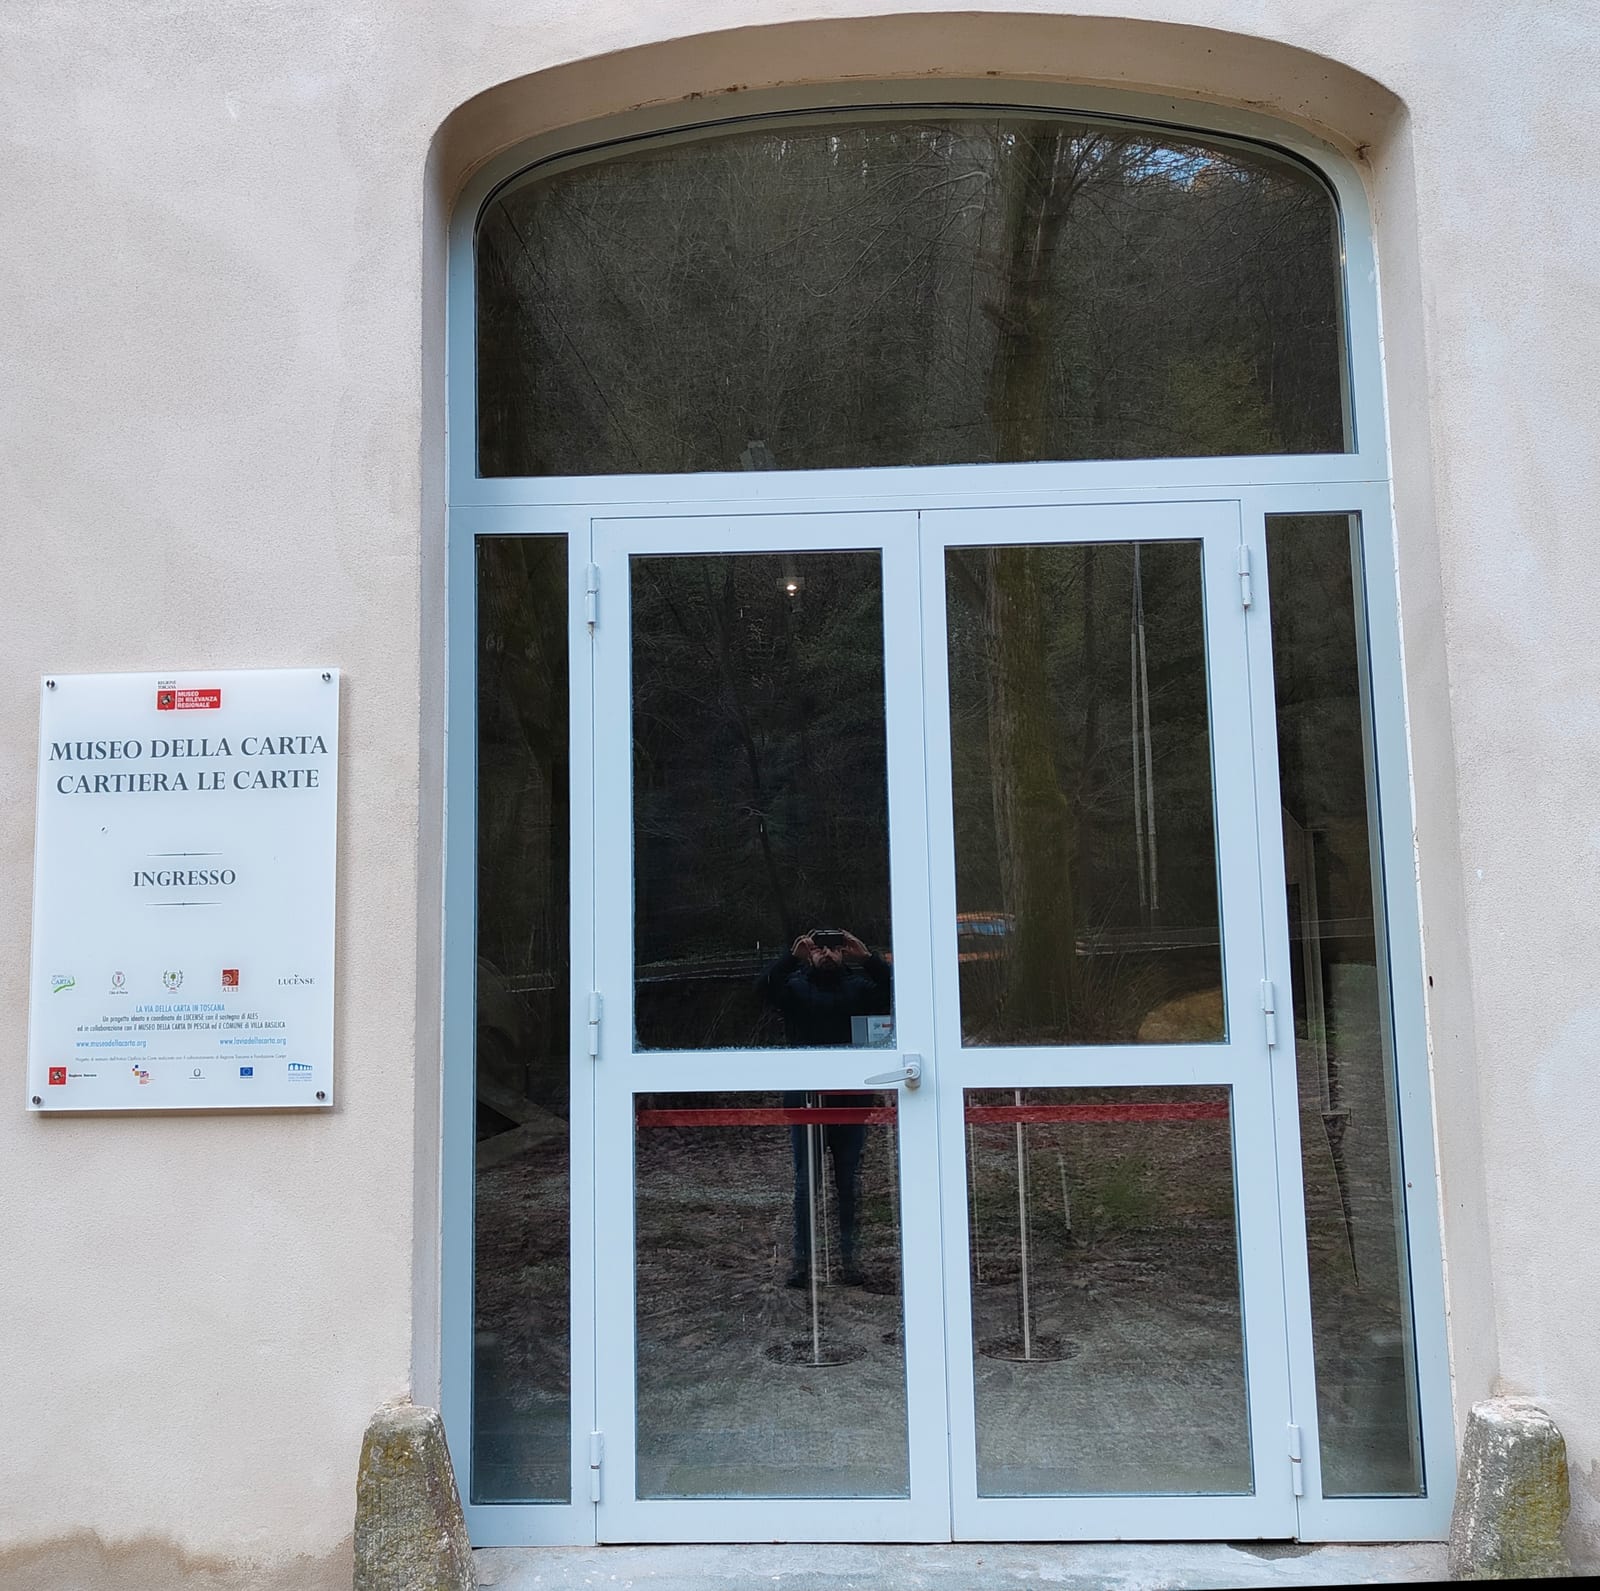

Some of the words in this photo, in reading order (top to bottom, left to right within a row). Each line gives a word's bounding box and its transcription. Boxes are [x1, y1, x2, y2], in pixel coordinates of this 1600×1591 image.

[48, 740, 142, 761] MUSEO
[150, 737, 233, 759] DELLA
[240, 735, 329, 756] CARTA
[56, 772, 189, 795] CARTIERA
[196, 771, 226, 791] LE
[233, 769, 320, 790] CARTE
[133, 869, 236, 887] INGRESSO
[135, 1004, 143, 1013] LA
[144, 1004, 153, 1013] VIA
[155, 1004, 172, 1013] DELLA
[173, 1004, 191, 1012] CARTA
[200, 1003, 225, 1011] TOSCANA
[76, 1040, 147, 1048] www.museodellacarta.org
